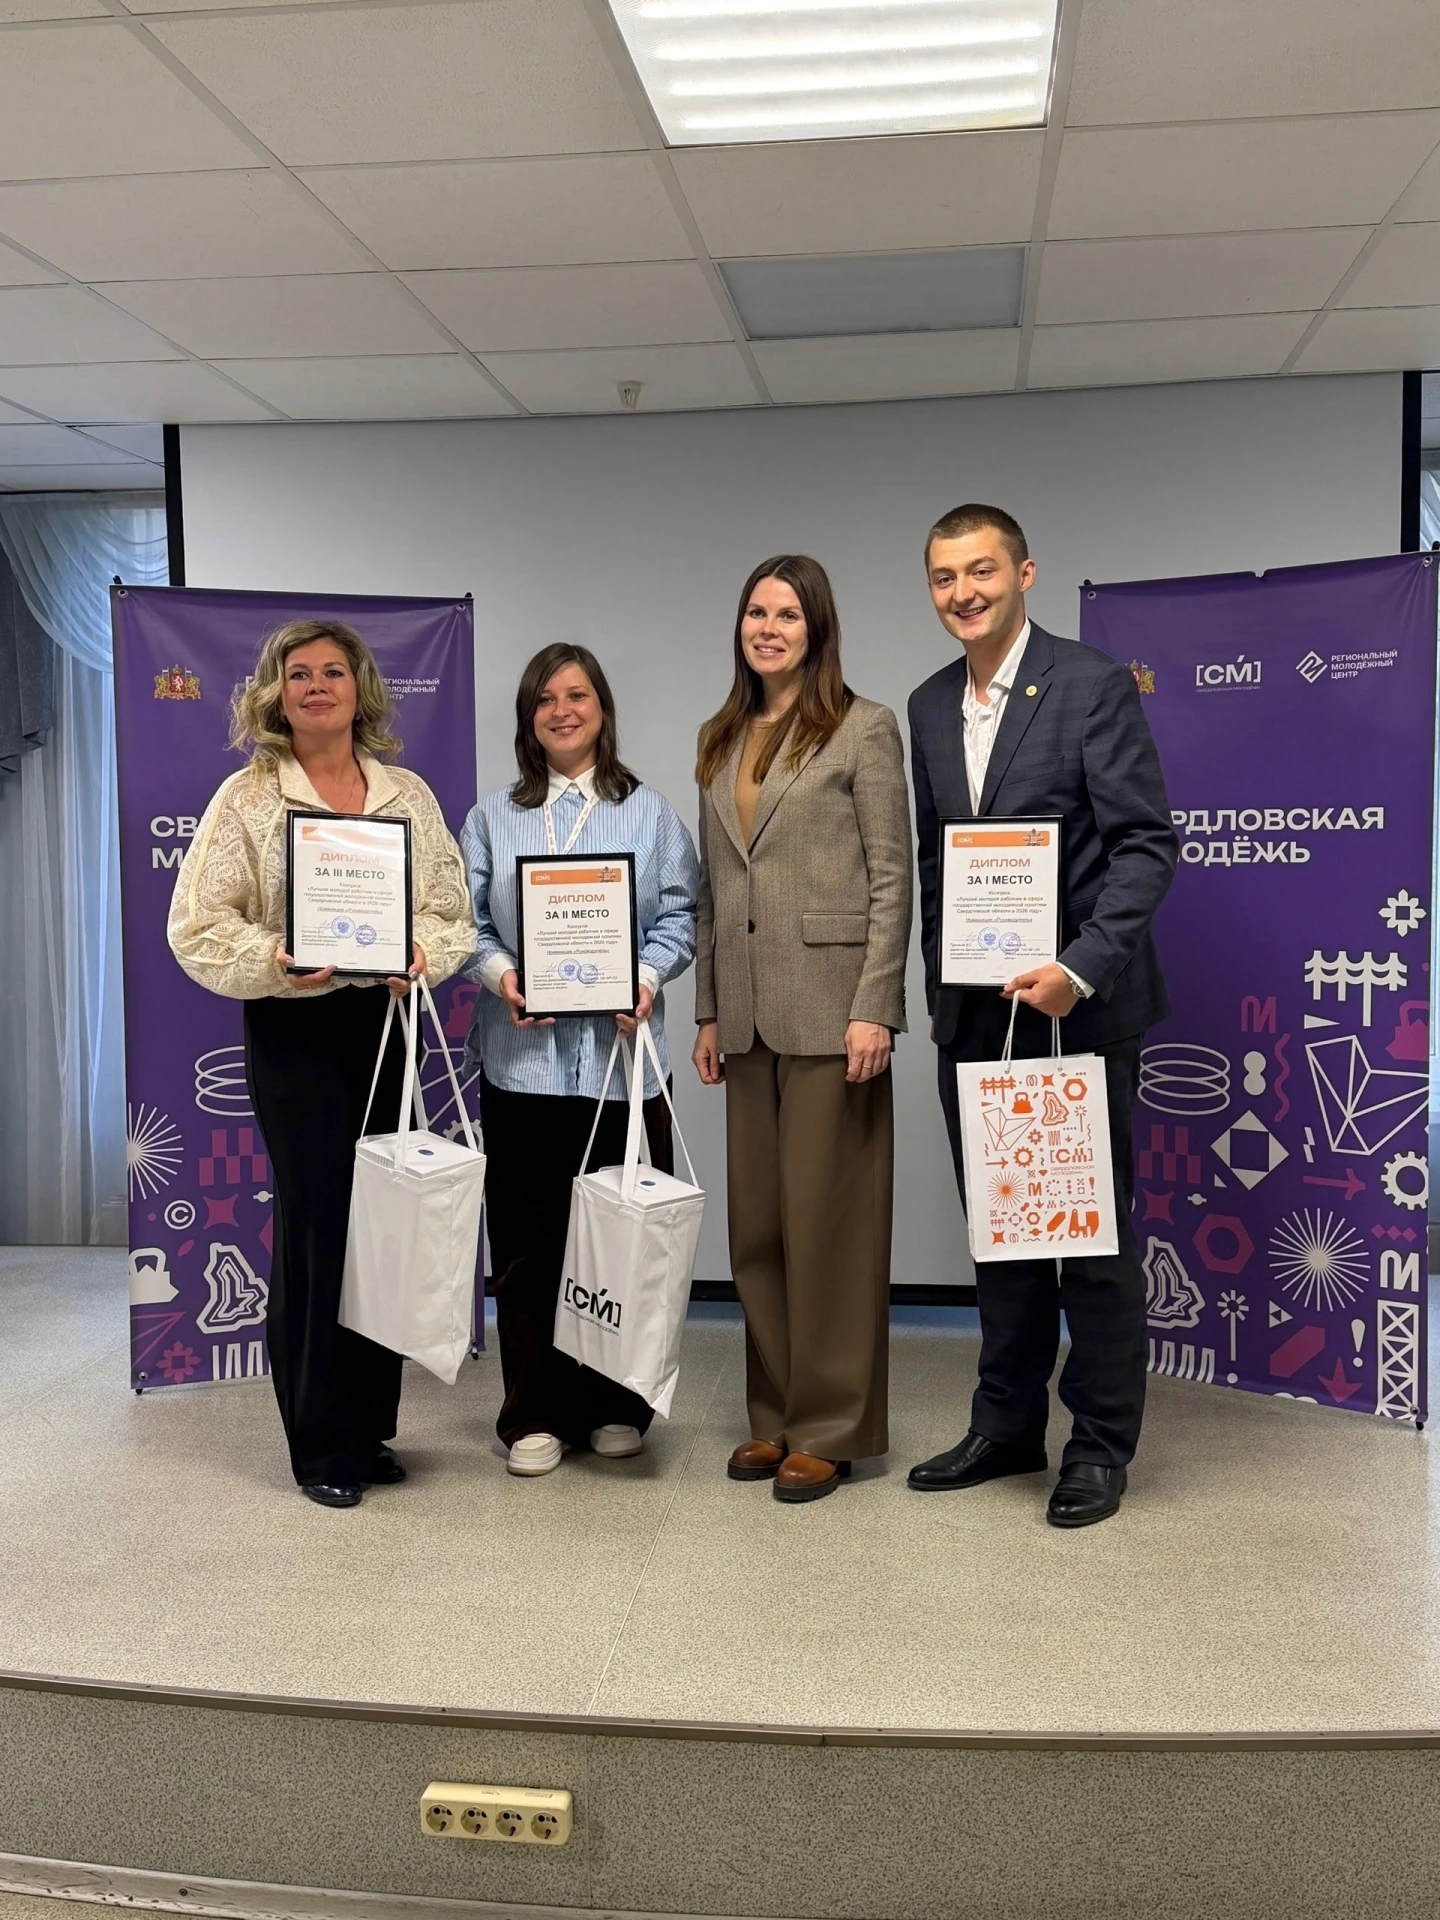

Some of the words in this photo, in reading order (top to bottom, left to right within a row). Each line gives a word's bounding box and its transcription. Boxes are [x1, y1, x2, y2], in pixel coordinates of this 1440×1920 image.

[1331, 649, 1398, 662] РЕГИОНАЛЬНЫЙ
[1331, 658, 1393, 670] МОЛОДЁЖНЫЙ
[1331, 671, 1358, 680] ЦЕНТР
[1170, 807, 1384, 835] РДЛОВСКАЯ
[1180, 835, 1311, 867] ОДЁЖЬ
[320, 852, 380, 864] ДИПЛОМ
[970, 858, 1030, 869] ДИПЛОМ
[314, 867, 330, 876] ЗА
[333, 868, 342, 877] III
[346, 869, 385, 880] МЕСТО
[967, 876, 982, 885] ЗА
[992, 875, 1033, 885] МЕСТО
[548, 894, 605, 905] ДИПЛОМ
[545, 911, 559, 919] ЗА
[562, 911, 568, 919] II
[571, 909, 609, 918] МЕСТО
